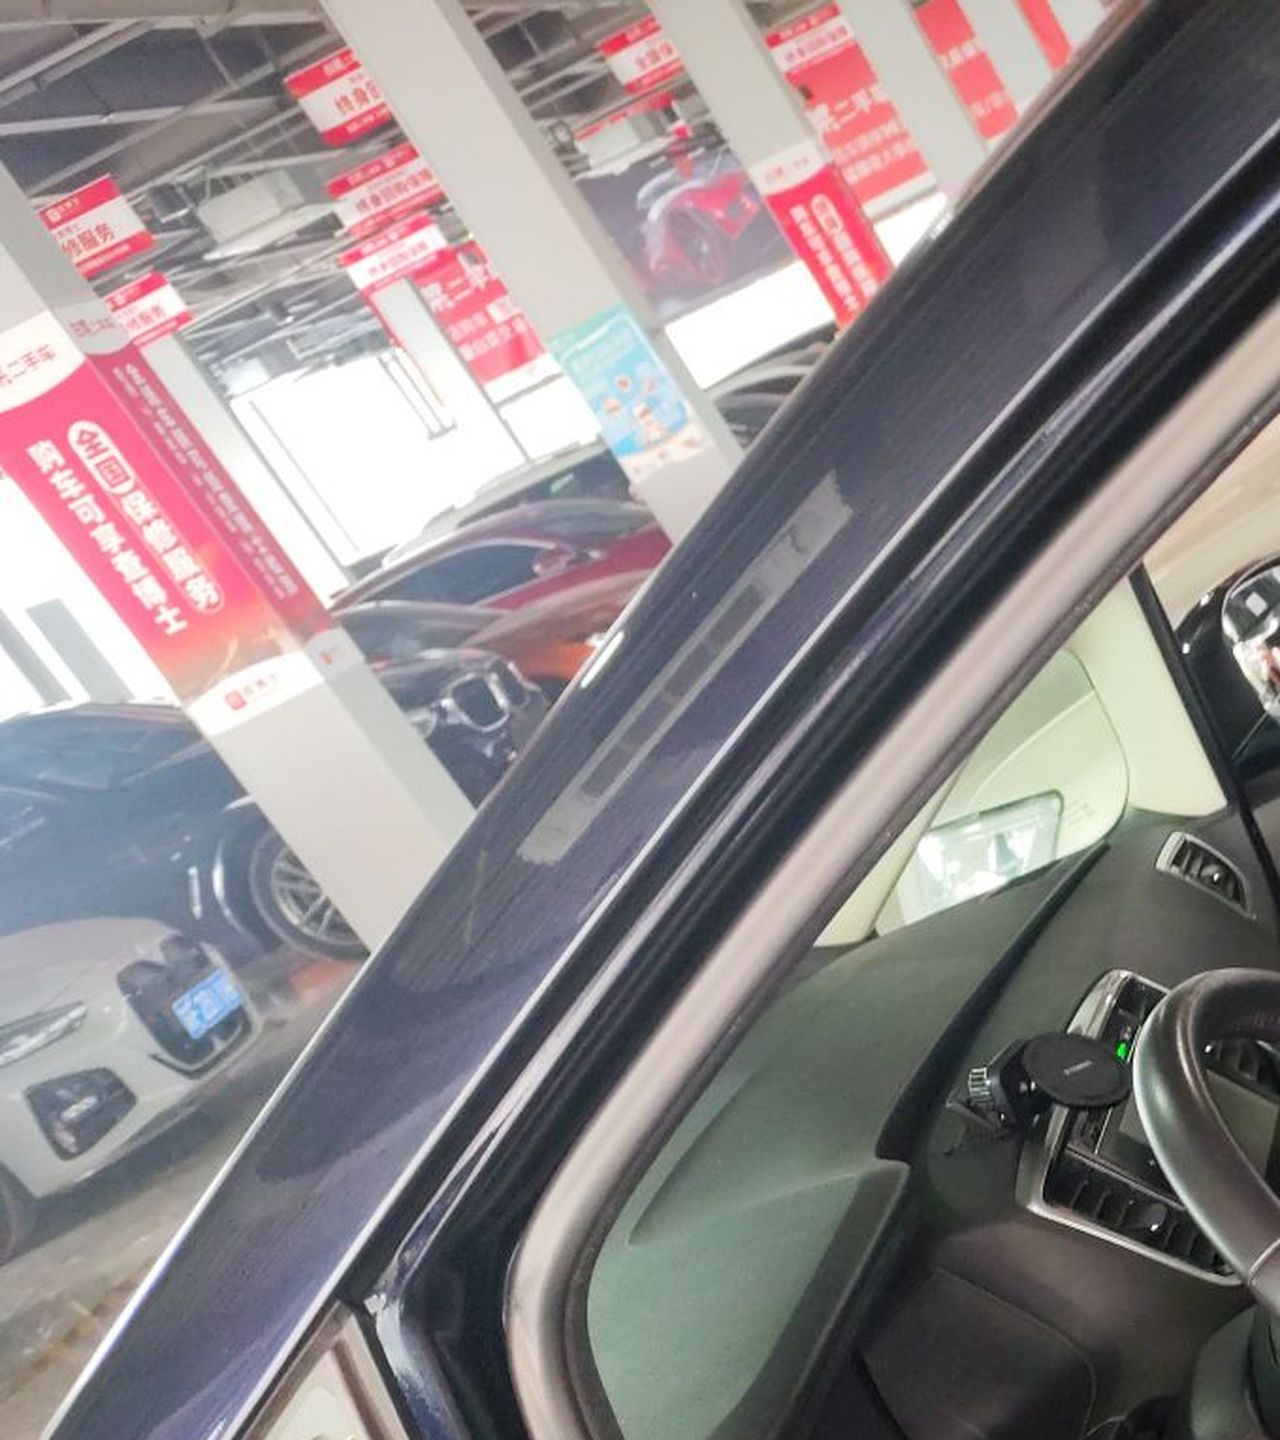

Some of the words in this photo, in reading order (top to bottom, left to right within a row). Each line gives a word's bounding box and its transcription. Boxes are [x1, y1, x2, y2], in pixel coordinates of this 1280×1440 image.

[0, 344, 57, 386] 二手车
[26, 439, 188, 636] 购车可享查博士
[73, 426, 221, 610] 全国保修服务
